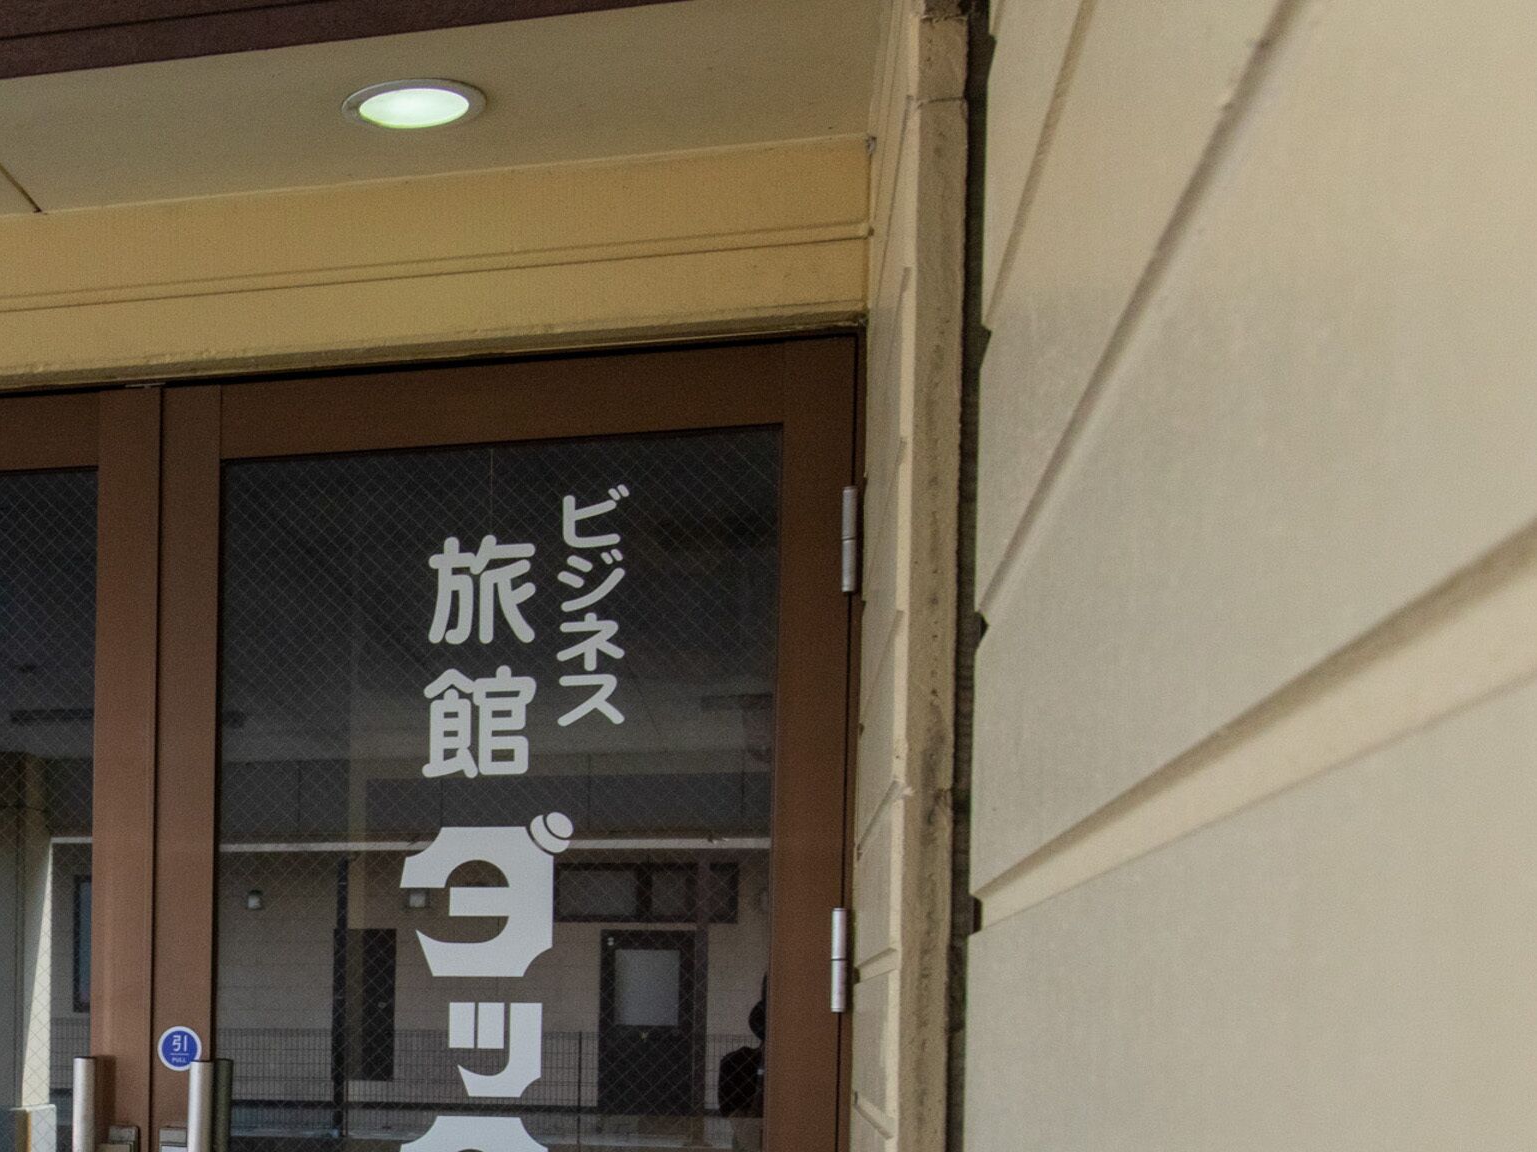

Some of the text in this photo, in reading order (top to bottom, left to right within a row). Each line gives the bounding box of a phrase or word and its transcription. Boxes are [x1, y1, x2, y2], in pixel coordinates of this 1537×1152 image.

[422, 534, 537, 778] 旅館
[557, 484, 629, 727] ビジネス
[172, 1034, 187, 1052] 引
